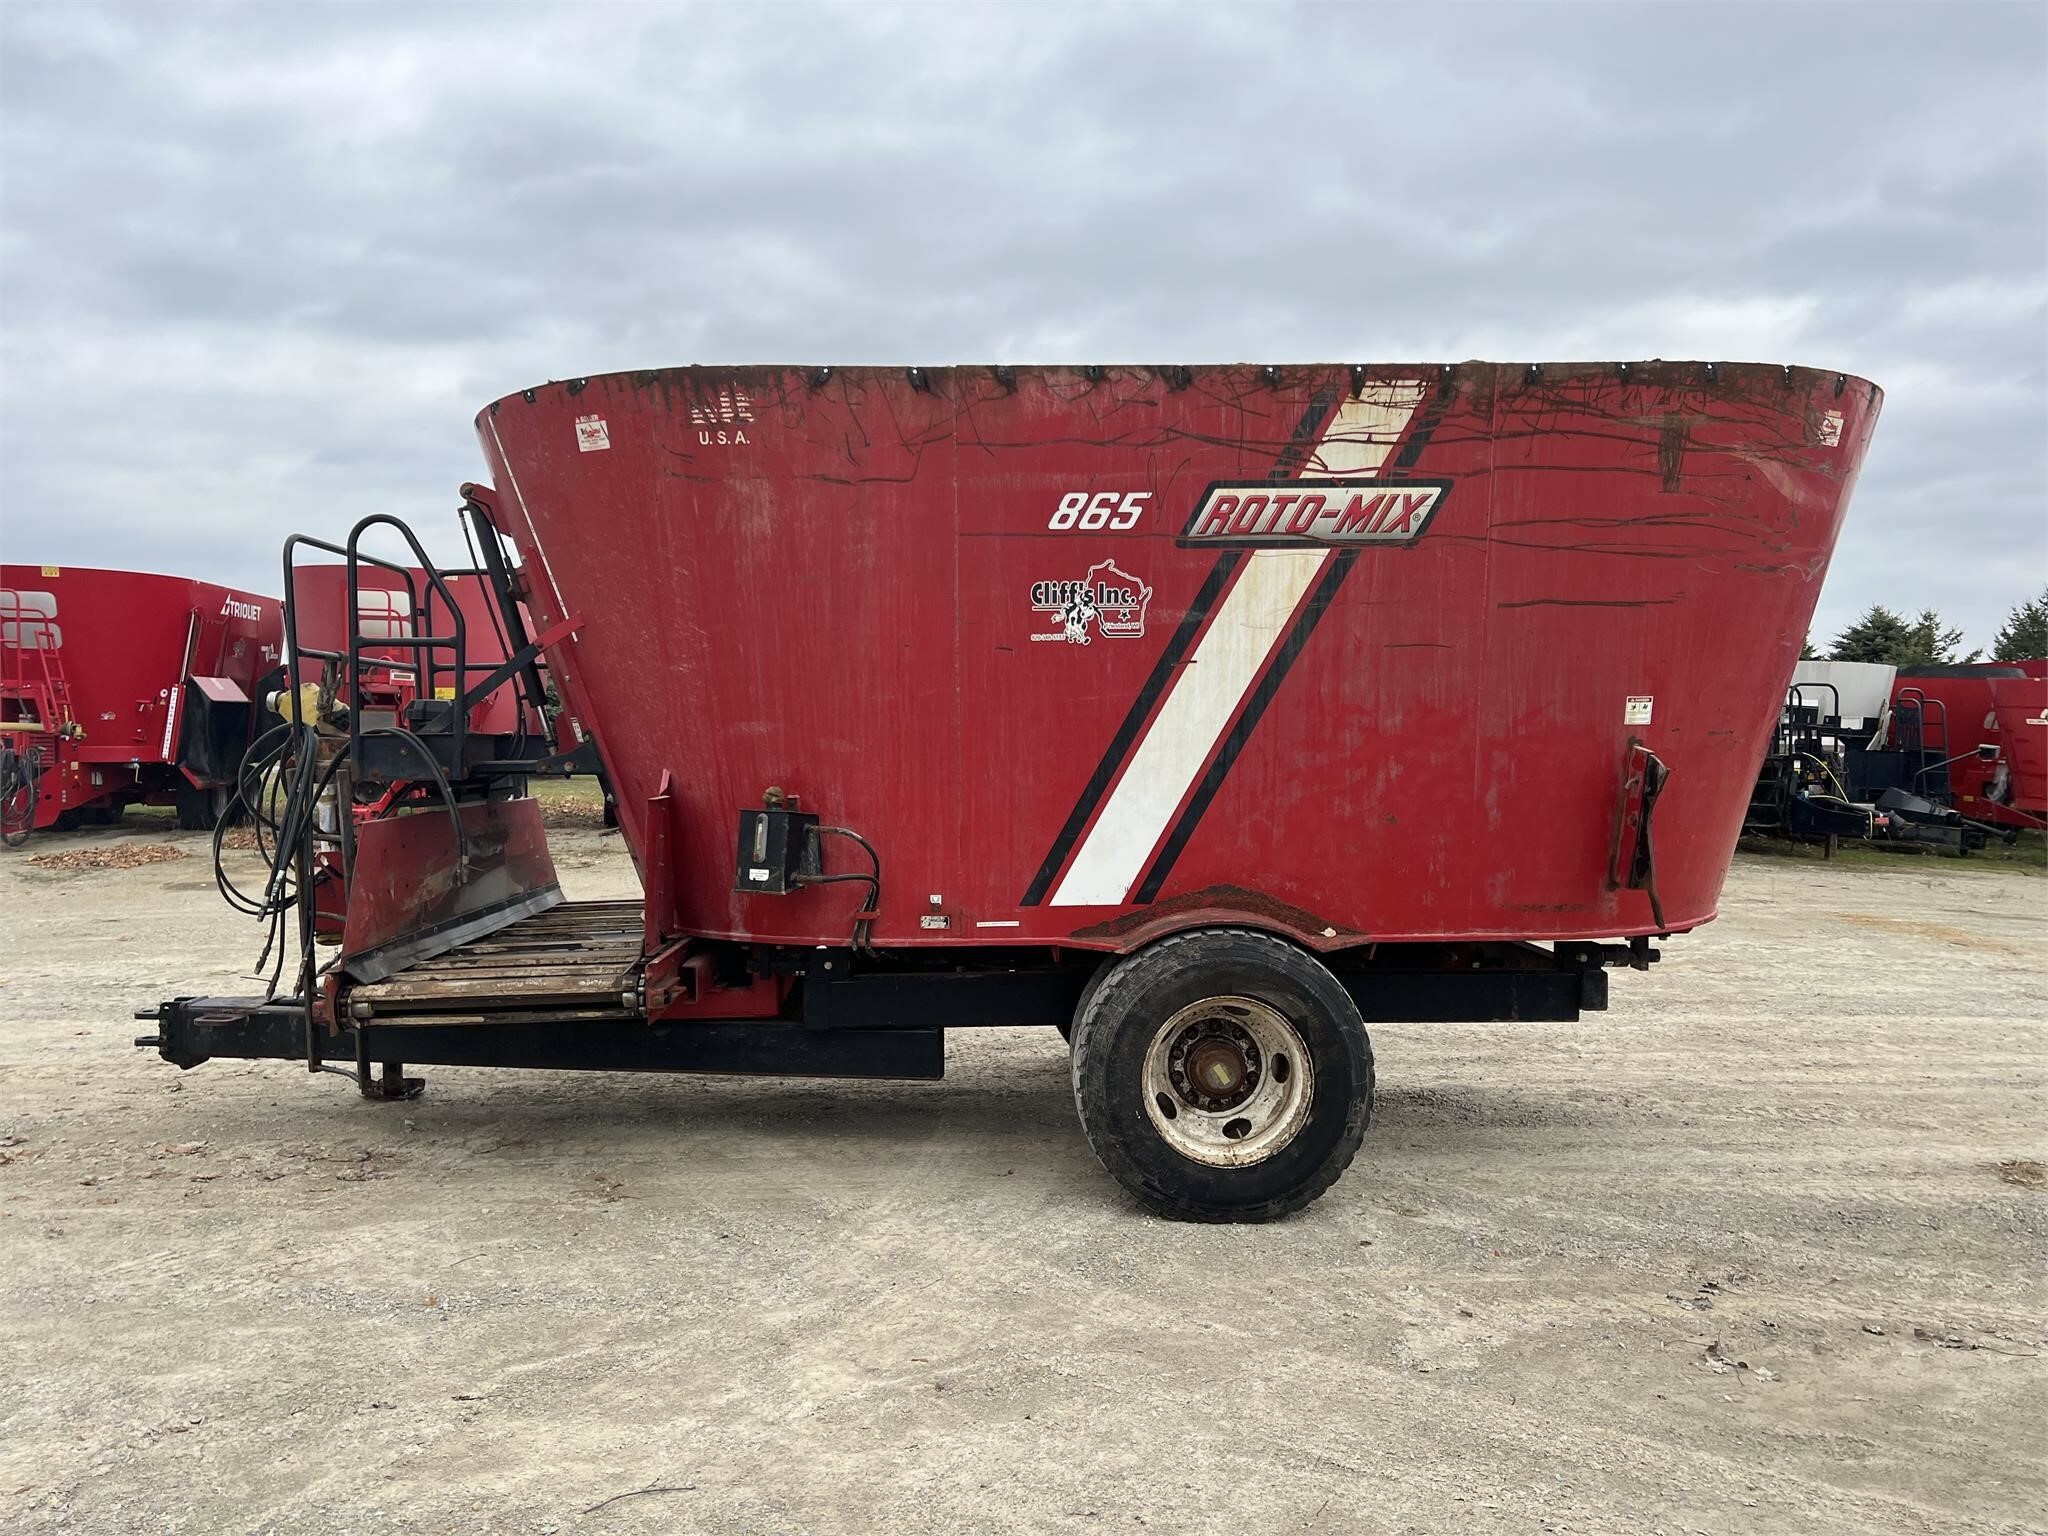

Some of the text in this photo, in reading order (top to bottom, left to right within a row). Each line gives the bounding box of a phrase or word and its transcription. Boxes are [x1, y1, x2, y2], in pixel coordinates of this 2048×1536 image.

[1048, 492, 1153, 530] 865
[1196, 493, 1434, 534] ROTO-MIX
[1031, 582, 1137, 605] Cliff's Inc.
[230, 600, 262, 621] TRIOLIET
